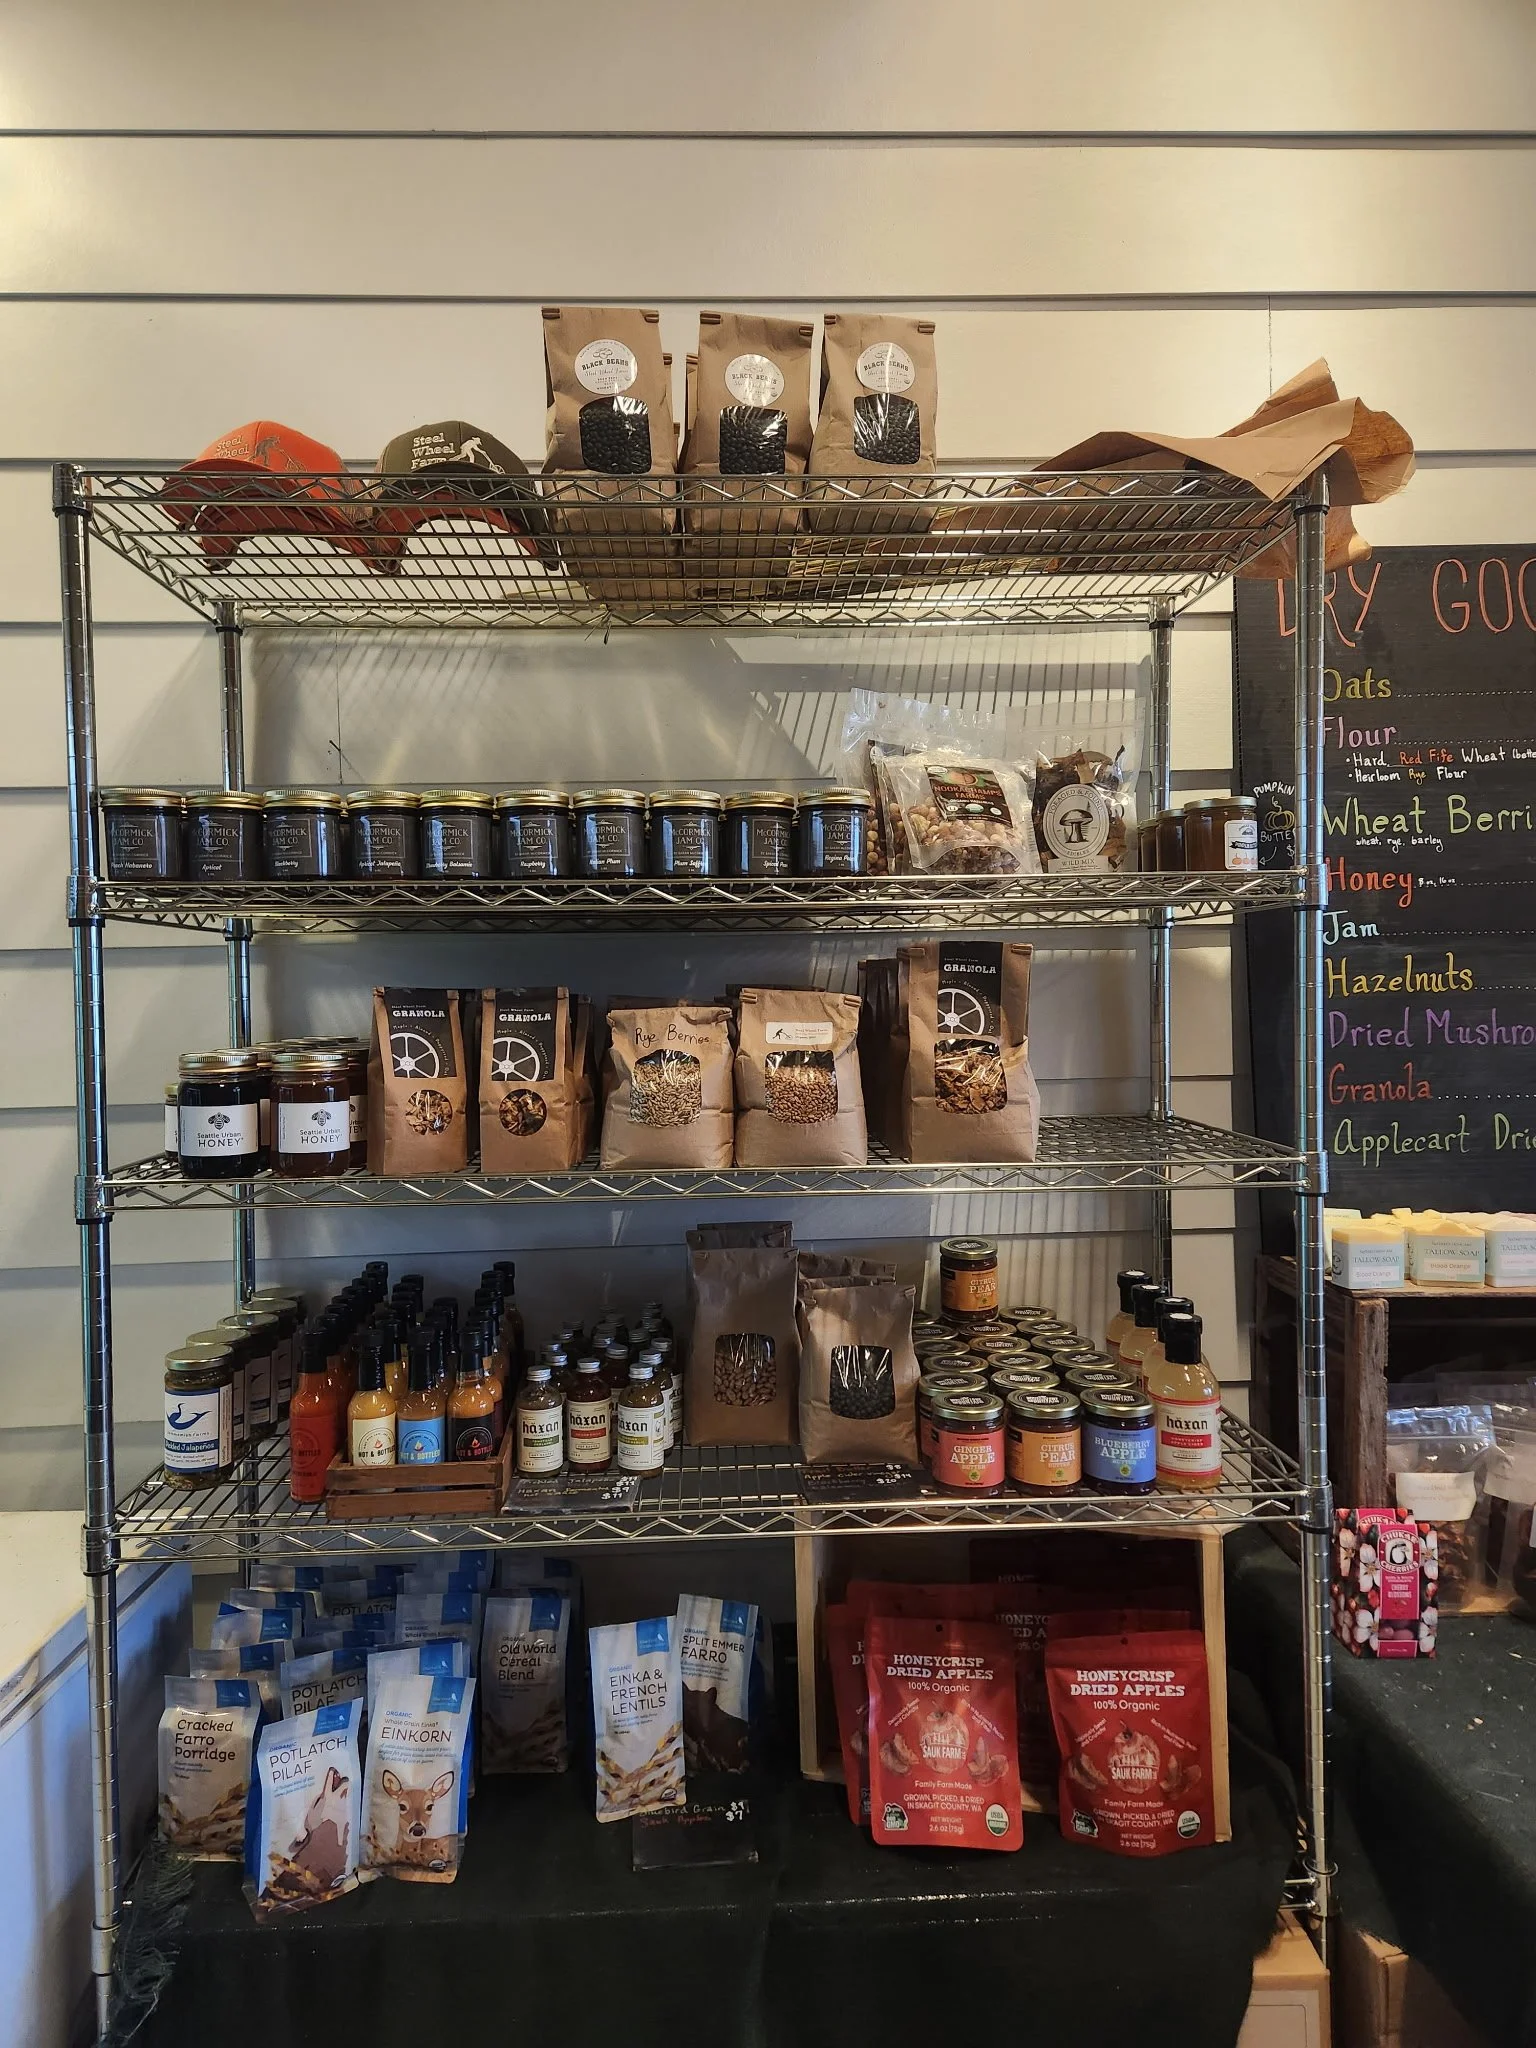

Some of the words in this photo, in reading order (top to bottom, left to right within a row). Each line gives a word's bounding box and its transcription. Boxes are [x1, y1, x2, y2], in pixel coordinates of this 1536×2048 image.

[581, 359, 604, 371] BLACK
[606, 358, 629, 367] BEANS
[863, 360, 885, 371] BLACK
[413, 432, 445, 447] Steel
[411, 442, 456, 458] Wheel
[1323, 668, 1393, 702] Oats
[1323, 716, 1397, 749] Flour
[1400, 751, 1423, 765] Red
[1429, 748, 1454, 763] Fife
[1461, 746, 1506, 763] Wheat
[1355, 768, 1400, 783] Heirloom
[1408, 768, 1427, 786] Rye
[1436, 767, 1467, 780] Flour
[955, 792, 985, 800] FARMS
[1253, 781, 1295, 798] PUMPKIN
[1049, 789, 1076, 815] FORAGED
[1084, 789, 1103, 813] FOUND
[1323, 795, 1427, 836] Wheat
[1447, 794, 1533, 834] Berri
[517, 837, 533, 846] JAM
[676, 837, 693, 845] JAM
[828, 832, 844, 840] JAM
[1411, 834, 1444, 853] barley
[824, 854, 842, 864] Regina
[1324, 856, 1414, 907] Honey
[1323, 910, 1380, 945] Jam
[943, 963, 996, 974] GRANOLA
[1325, 951, 1474, 998] Hazelnuts
[392, 1010, 446, 1018] GRANOLA
[499, 1013, 551, 1022] GRANOLA
[1328, 1006, 1414, 1048] Dried
[635, 1027, 658, 1049] Rye
[667, 1023, 710, 1046] Berries
[1327, 1062, 1434, 1105] Granola
[198, 1138, 241, 1148] HONEY
[300, 1134, 340, 1144] HONEY
[1333, 1114, 1471, 1168] Applecart
[1425, 1248, 1456, 1256] TALLOW
[1354, 1256, 1381, 1264] TALLOW
[969, 1282, 996, 1294] PEAR
[569, 1413, 606, 1426] häxan
[1166, 1415, 1208, 1430] häxan
[522, 1421, 559, 1434] häxan
[180, 1442, 215, 1452] Jalapeños
[953, 1445, 993, 1454] GINGER
[1040, 1442, 1074, 1452] CITRUS
[1095, 1436, 1151, 1450] BLUEBERRY
[410, 1452, 415, 1460] &
[949, 1451, 995, 1465] APPLE
[1039, 1450, 1076, 1463] PEAR
[1100, 1447, 1147, 1460] APPLE
[1380, 1531, 1419, 1544] CHUKAR
[1380, 1560, 1419, 1573] CHERRIES
[500, 1644, 520, 1655] Old
[523, 1643, 557, 1654] World
[682, 1635, 710, 1647] SPLIT
[712, 1639, 745, 1653] EMMER
[499, 1656, 541, 1667] Cereal
[680, 1646, 727, 1664] FARRO
[893, 1654, 985, 1668] HONEYCRISP
[498, 1668, 535, 1681] Blend
[610, 1670, 651, 1687] EINKA
[654, 1668, 663, 1680] &
[886, 1666, 932, 1678] DRIED
[936, 1669, 994, 1680] APPLES
[1076, 1670, 1175, 1683] HONEYCRISP
[291, 1674, 367, 1702] POTLATCH
[611, 1681, 667, 1701] FRENCH
[907, 1681, 931, 1691] 100%
[931, 1682, 971, 1695] Organic
[1070, 1684, 1119, 1696] DRIED
[1122, 1685, 1186, 1697] APPLES
[612, 1696, 666, 1716] LENTILS
[1093, 1700, 1118, 1710] 100%
[1118, 1699, 1161, 1713] Organic
[177, 1719, 234, 1732] Cracked
[175, 1732, 215, 1746] Farro
[381, 1726, 452, 1743] EINKORN
[175, 1746, 236, 1763] Porridge
[269, 1735, 348, 1769] POTLATCH
[922, 1746, 941, 1759] SAUK
[942, 1746, 961, 1760] FARM
[272, 1759, 313, 1784] PILAF
[1111, 1767, 1132, 1780] SAUK
[1131, 1767, 1153, 1780] FARM
[914, 1780, 936, 1790] Family
[936, 1780, 954, 1789] Farm
[954, 1782, 972, 1790] Made
[965, 1796, 985, 1804] DRIED
[1104, 1799, 1127, 1809] Family
[1127, 1800, 1145, 1808] Farm
[693, 1804, 726, 1814] Grain
[971, 1804, 983, 1813] WA
[1157, 1809, 1175, 1819] DRIED
[725, 1809, 743, 1822] $7
[1162, 1818, 1174, 1826] WA
[929, 1824, 939, 1833] 2.6
